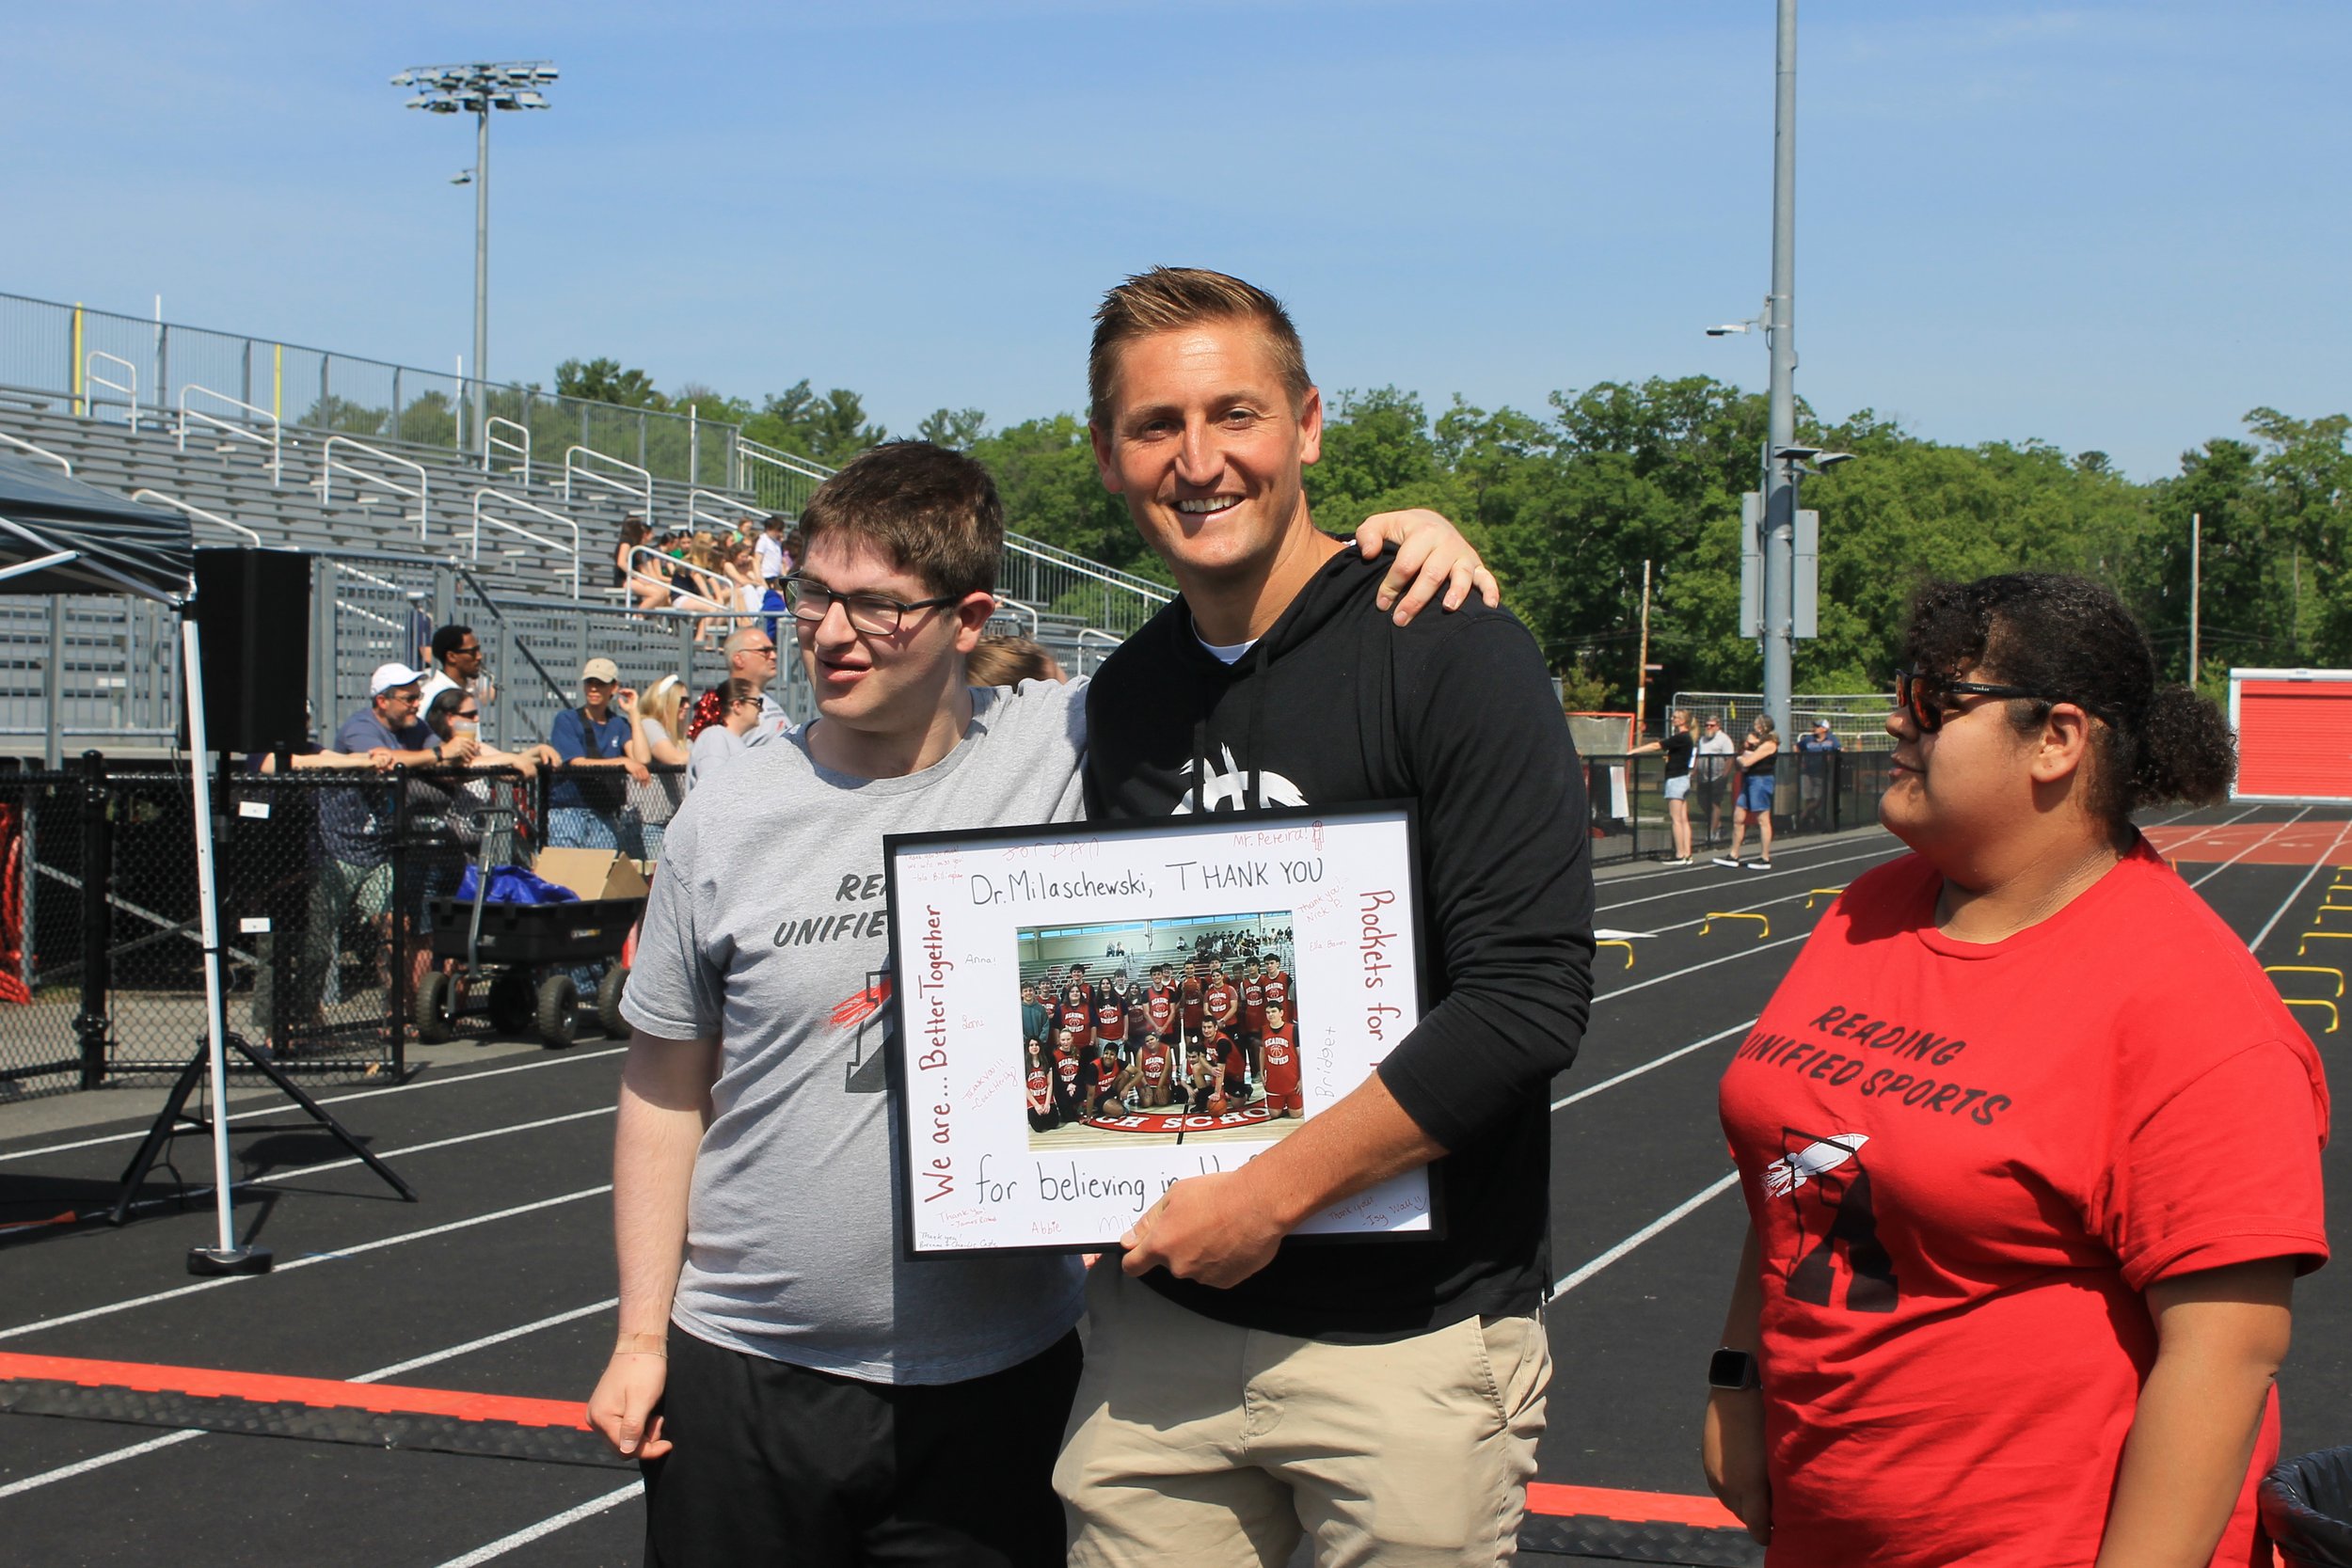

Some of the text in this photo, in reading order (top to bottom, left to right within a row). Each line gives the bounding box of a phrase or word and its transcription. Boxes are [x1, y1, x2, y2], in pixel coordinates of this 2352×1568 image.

[1165, 861, 1269, 891] THANK
[1279, 857, 1323, 884] YOU
[917, 904, 954, 1000] Together
[1359, 890, 1402, 1041] Rockets for
[918, 995, 947, 1071] Better
[1314, 1025, 1337, 1099] Bridget
[1808, 1005, 1967, 1067] READING
[1738, 1031, 2012, 1127] UNIFIED SPORTS
[922, 1156, 954, 1203] We
[976, 1153, 1018, 1205] for
[1036, 1161, 1145, 1212] believing
[1030, 1221, 1063, 1235] Abbie
